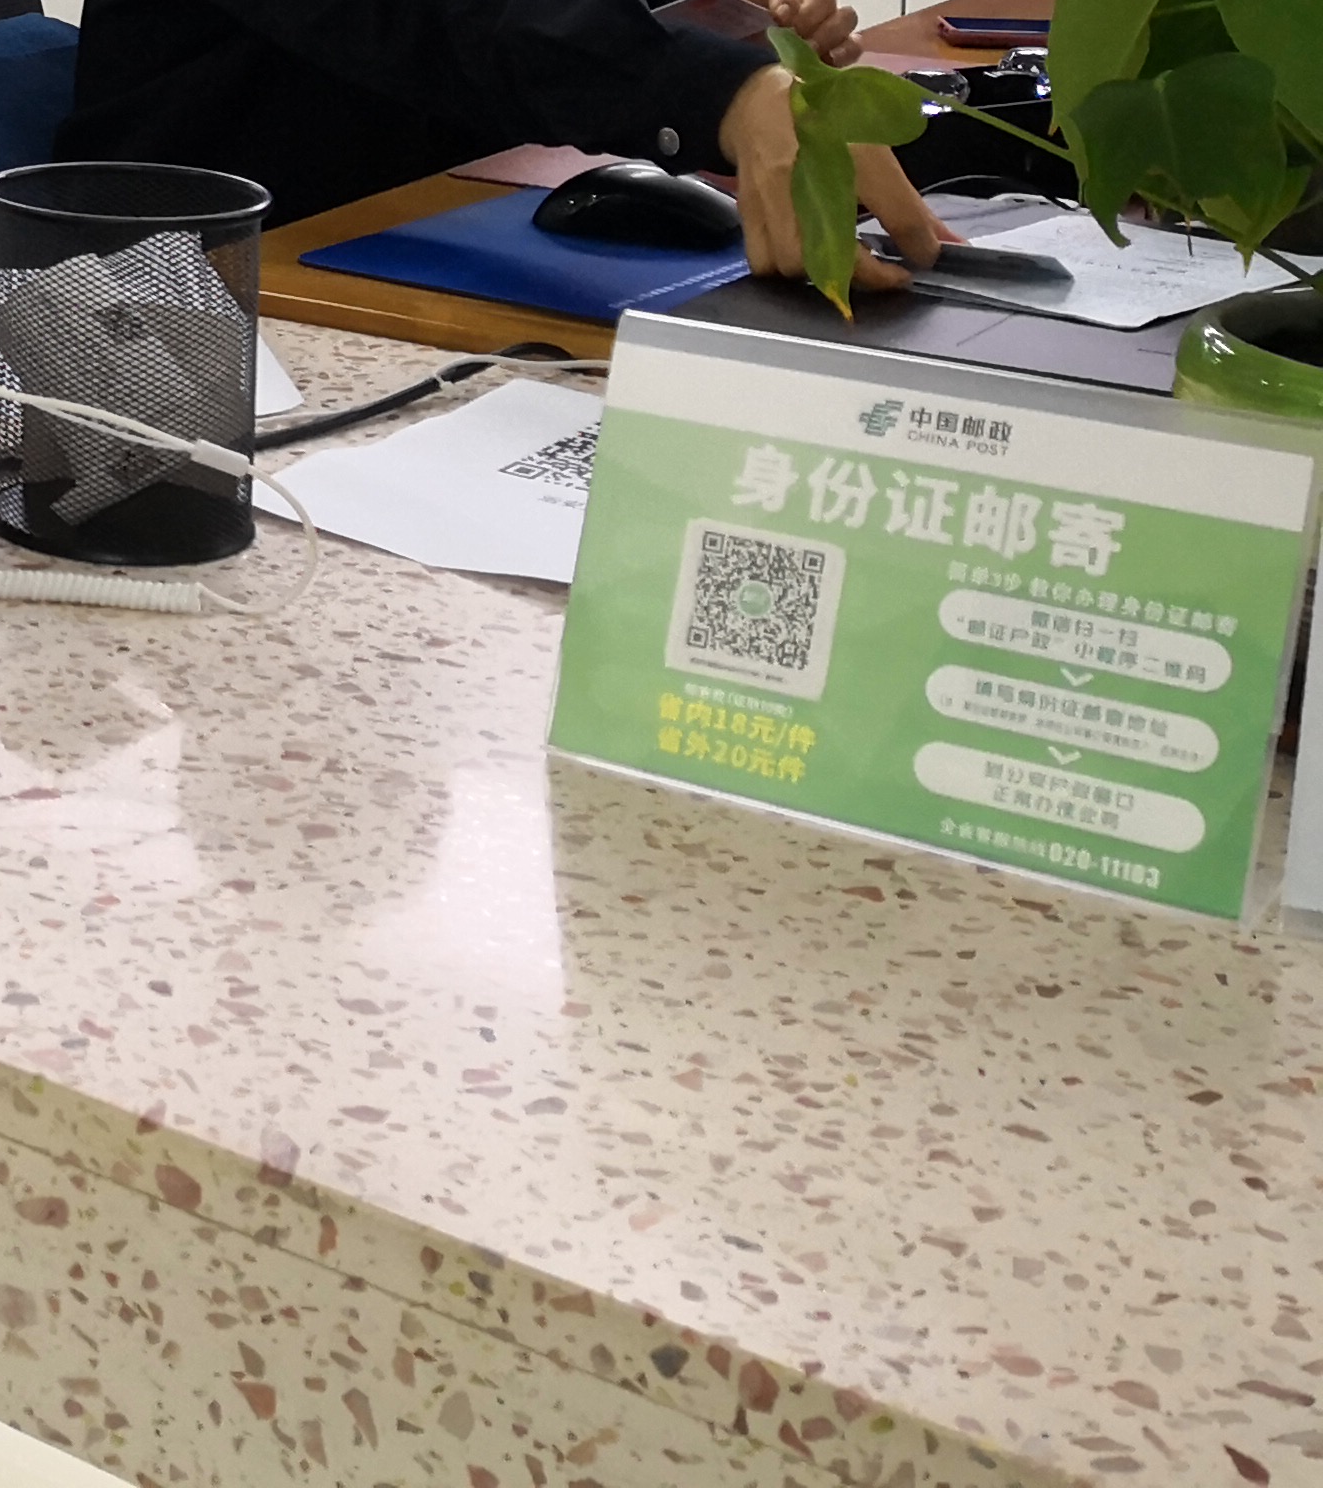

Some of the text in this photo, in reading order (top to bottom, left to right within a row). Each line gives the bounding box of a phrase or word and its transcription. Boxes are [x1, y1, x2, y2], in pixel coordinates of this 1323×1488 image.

[906, 429, 1010, 457] CHINA POST
[909, 406, 1014, 444] 中国邮政
[731, 443, 1127, 577] 身份证邮寄
[658, 692, 817, 755] 省内18元/件
